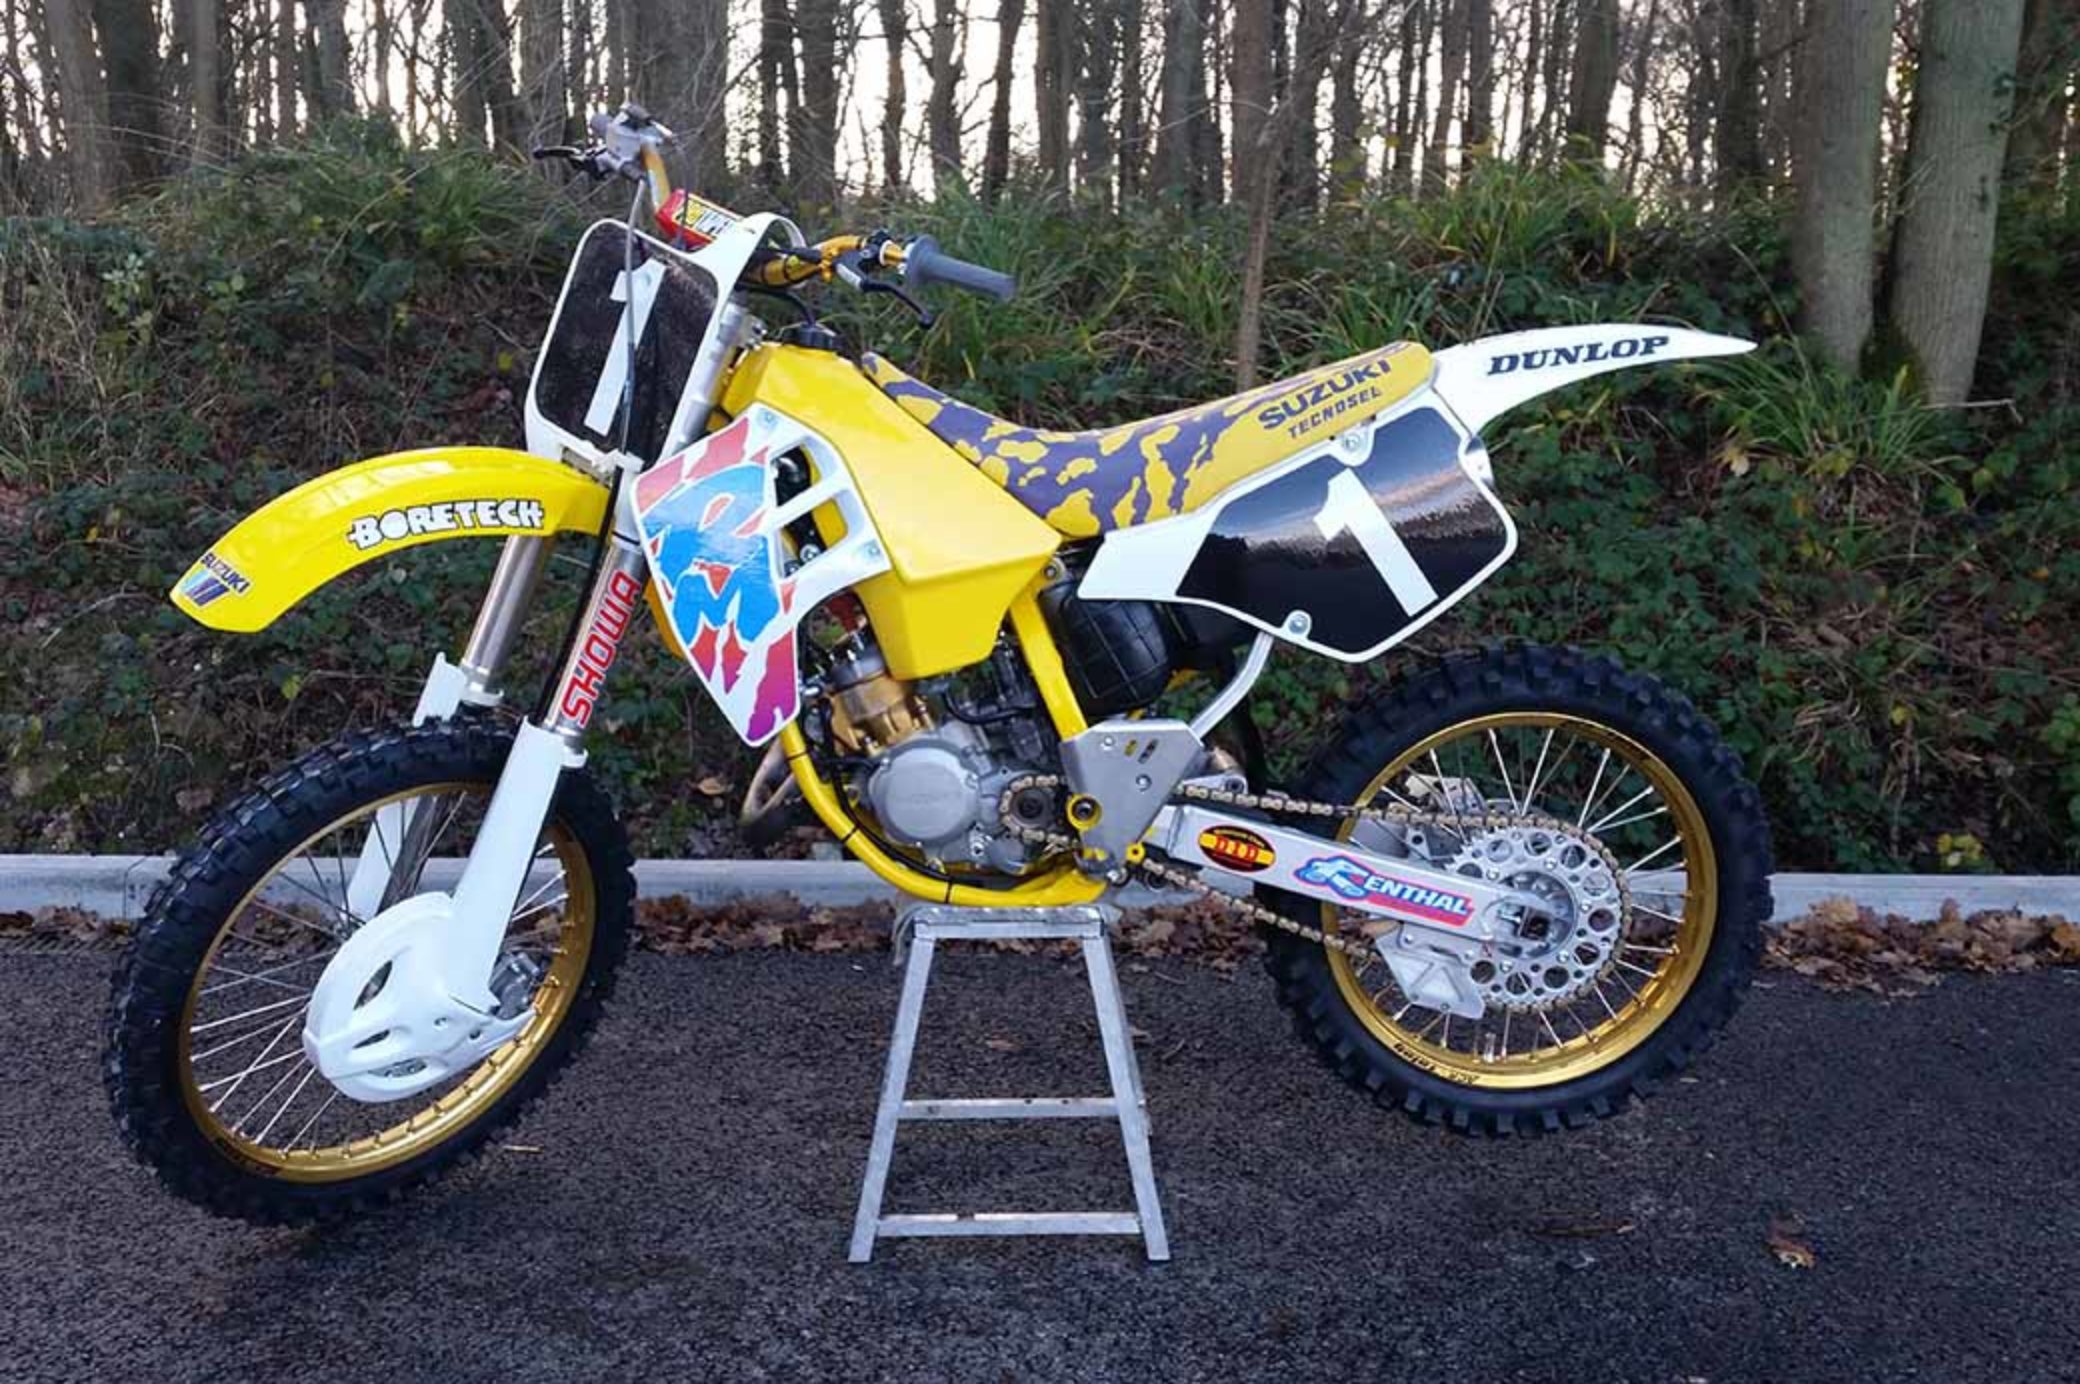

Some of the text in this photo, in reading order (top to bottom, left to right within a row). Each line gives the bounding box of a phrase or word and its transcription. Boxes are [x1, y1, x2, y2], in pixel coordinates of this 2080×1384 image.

[1487, 336, 1670, 376] DUNLOP
[1258, 359, 1392, 431] SUZUKI
[1287, 387, 1382, 440] TECNOSEL
[347, 499, 545, 550] BORETECH
[1313, 467, 1439, 617] 1
[201, 552, 251, 594] SUZUKI
[562, 569, 642, 727] SHOWA
